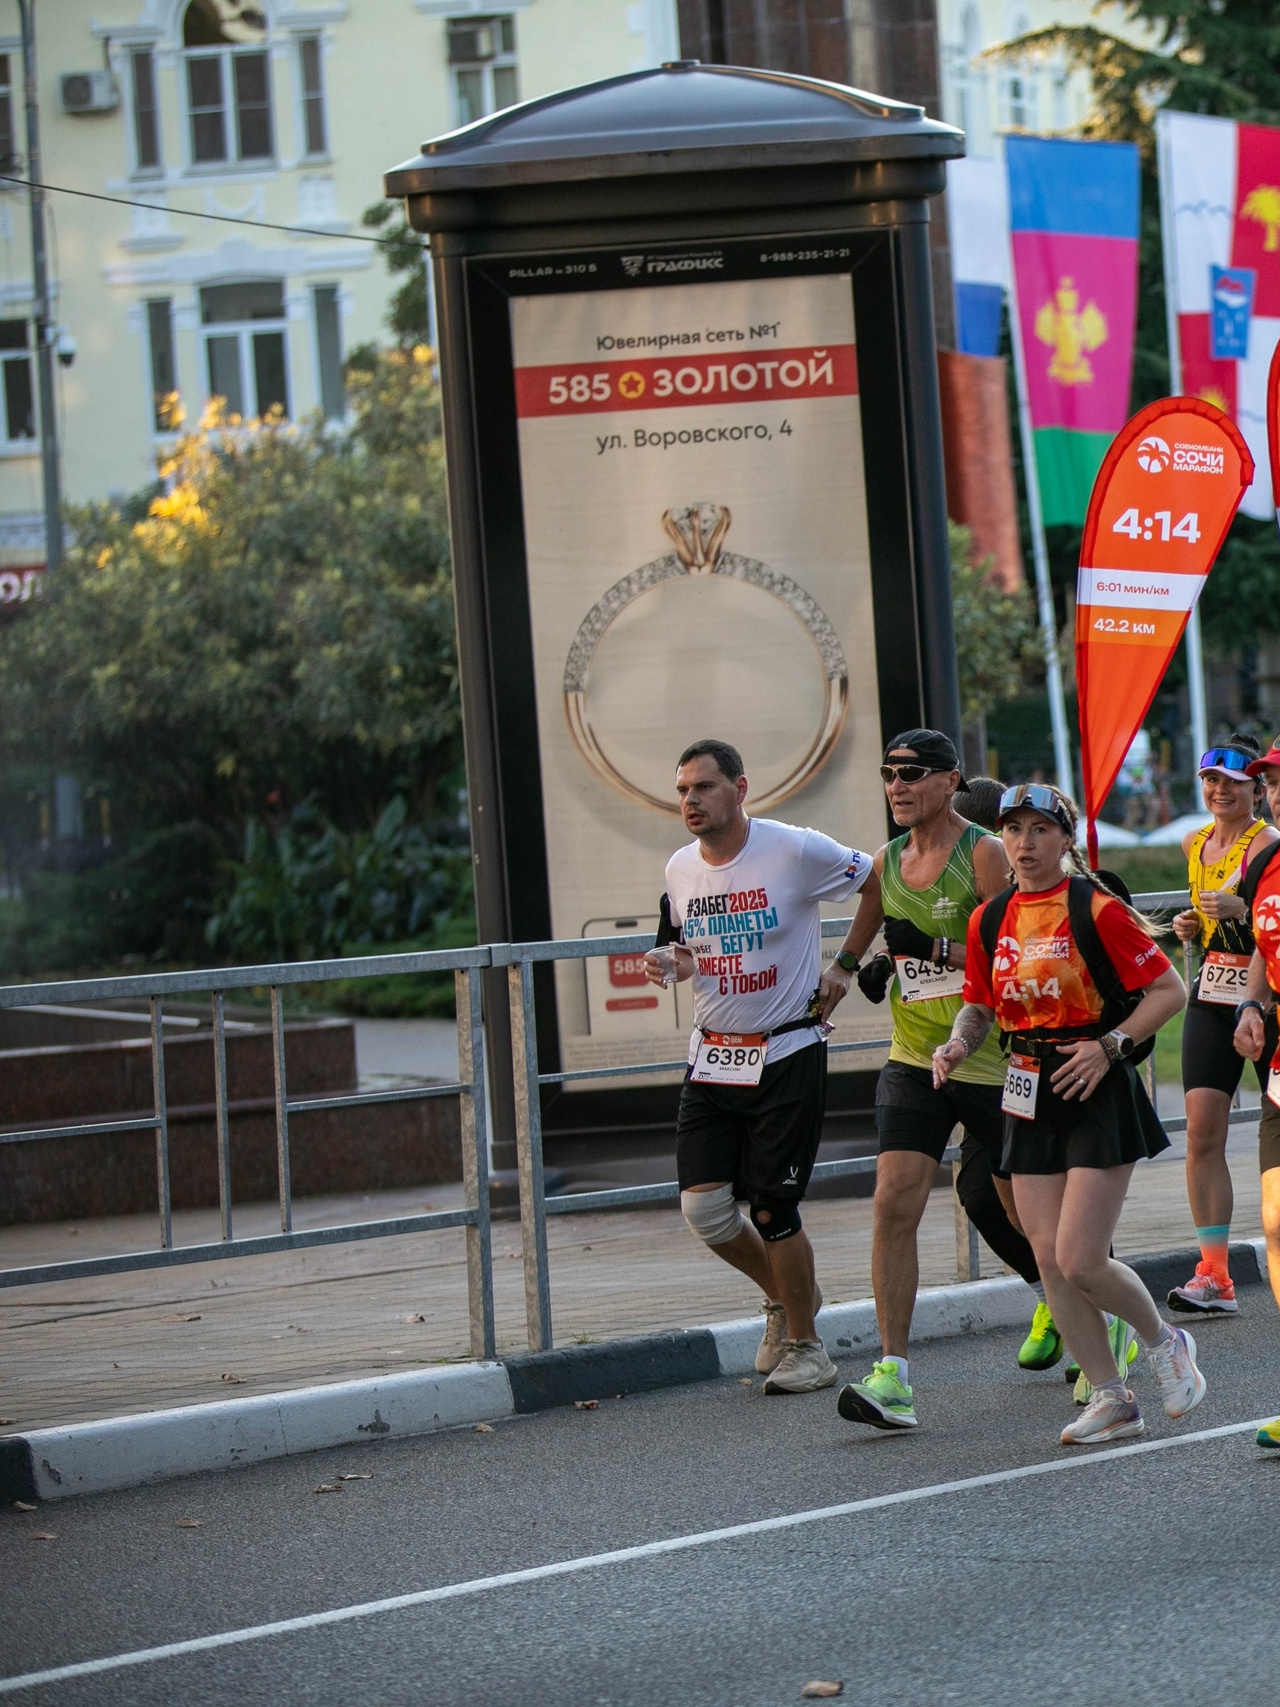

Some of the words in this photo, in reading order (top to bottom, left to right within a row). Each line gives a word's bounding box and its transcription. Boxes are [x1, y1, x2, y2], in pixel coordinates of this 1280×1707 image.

[508, 266, 552, 278] PILLAR
[647, 257, 724, 273] ГРАФИКС
[597, 332, 701, 350] Ювелирная
[706, 329, 745, 343] сеть
[548, 374, 611, 404] 585
[653, 350, 834, 397] ЗОЛОТОЙ
[596, 431, 628, 455] ул.
[634, 421, 773, 450] Воровского,
[780, 419, 793, 437] 4
[1174, 443, 1223, 452] СОВКОМБАНК
[1173, 450, 1224, 467] СОЧИ
[1173, 464, 1223, 474] МАРАФОН
[1112, 508, 1201, 543] 4:14
[1096, 582, 1121, 593] 6:01
[1124, 584, 1170, 597] мин/км
[1093, 618, 1129, 633] 42.2
[687, 888, 769, 918] #ЗАБЕГ2025
[708, 906, 780, 936] ПЛАНЕТЫ
[720, 932, 765, 955] БЕГУТ
[1023, 941, 1069, 956] СОЧИ
[1024, 936, 1069, 944] СОВКОМБАНК
[698, 954, 743, 977] ВМЕСТЕ
[1022, 951, 1069, 962] МАРАФОН
[614, 958, 645, 975] 585
[1206, 965, 1248, 986] 6729
[719, 976, 728, 995] С
[731, 964, 777, 995] ТОБОЙ
[920, 976, 948, 985] АЛЕКСАНДР
[1001, 977, 1062, 1001] 4:14
[706, 1047, 760, 1066] 6380
[1005, 1073, 1032, 1099] 669
